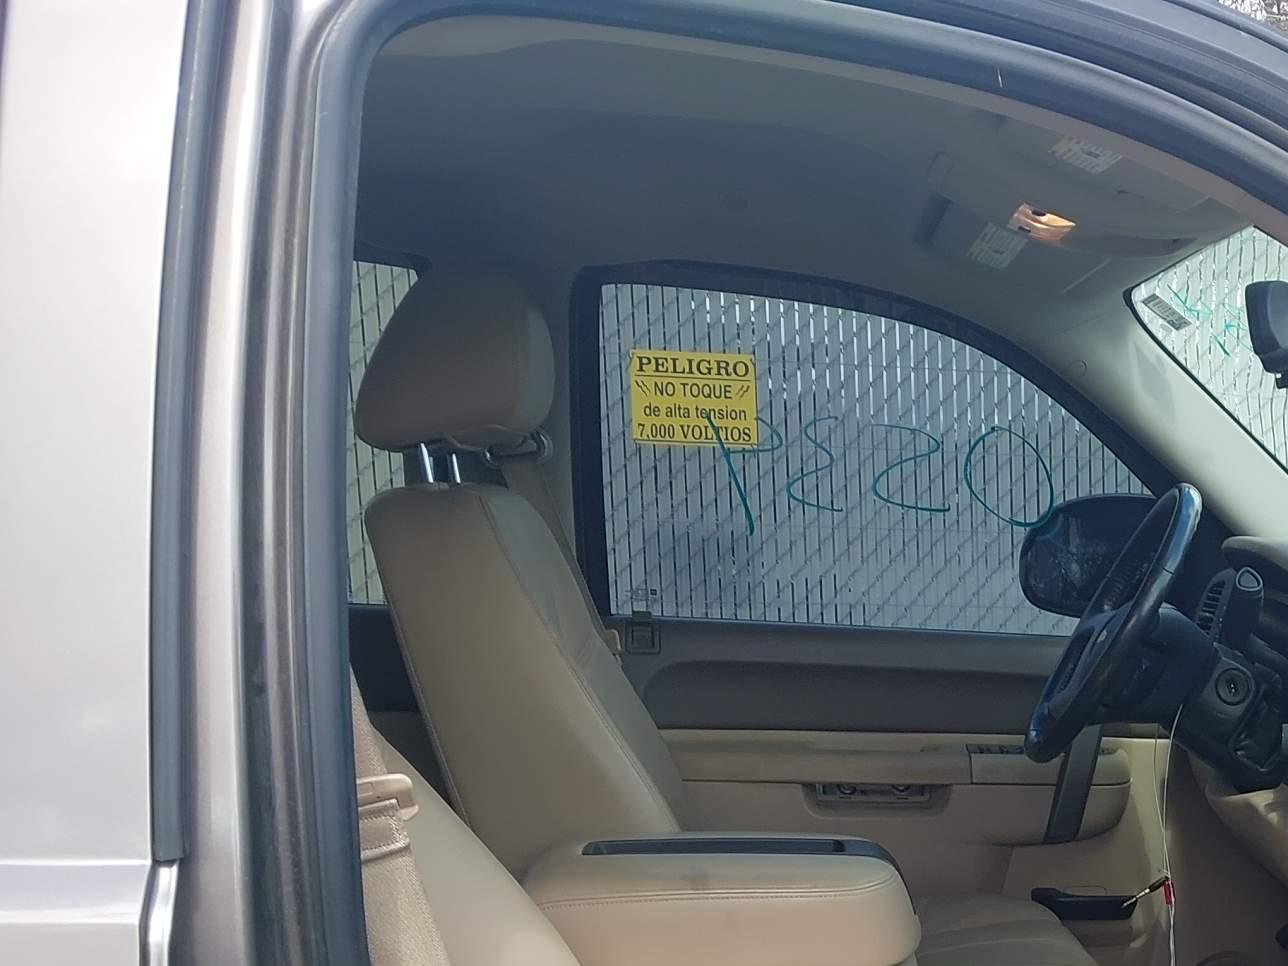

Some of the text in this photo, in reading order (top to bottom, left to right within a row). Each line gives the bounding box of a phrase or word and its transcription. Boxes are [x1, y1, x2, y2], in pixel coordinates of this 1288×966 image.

[636, 355, 750, 378] PELIGRO
[654, 381, 732, 399] NO TOQUE
[643, 402, 747, 421] de alta tension
[679, 424, 752, 442] VOLTIOS
